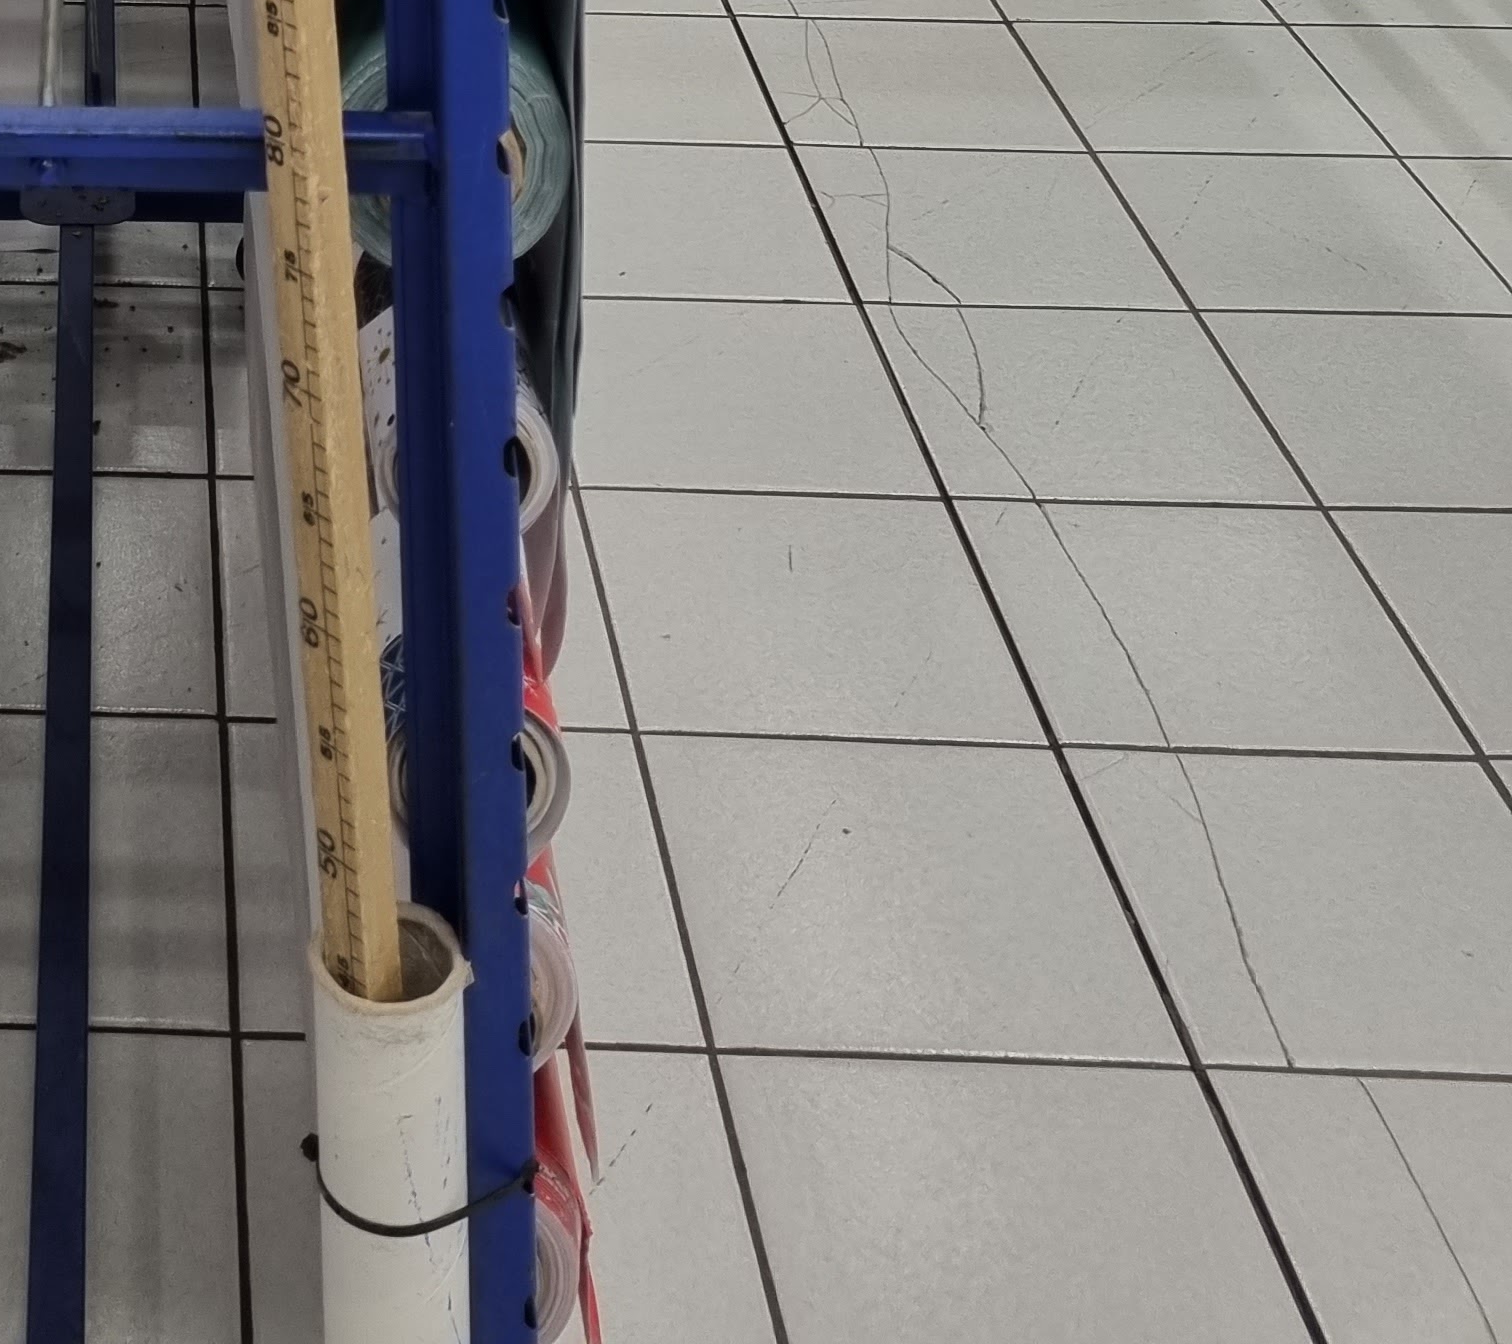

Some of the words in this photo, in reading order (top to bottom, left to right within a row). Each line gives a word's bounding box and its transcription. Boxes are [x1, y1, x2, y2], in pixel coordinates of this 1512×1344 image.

[263, 114, 286, 168] 80
[284, 249, 299, 284] 75
[281, 358, 303, 409] 70
[298, 596, 320, 650] 60
[316, 827, 338, 880] 50
